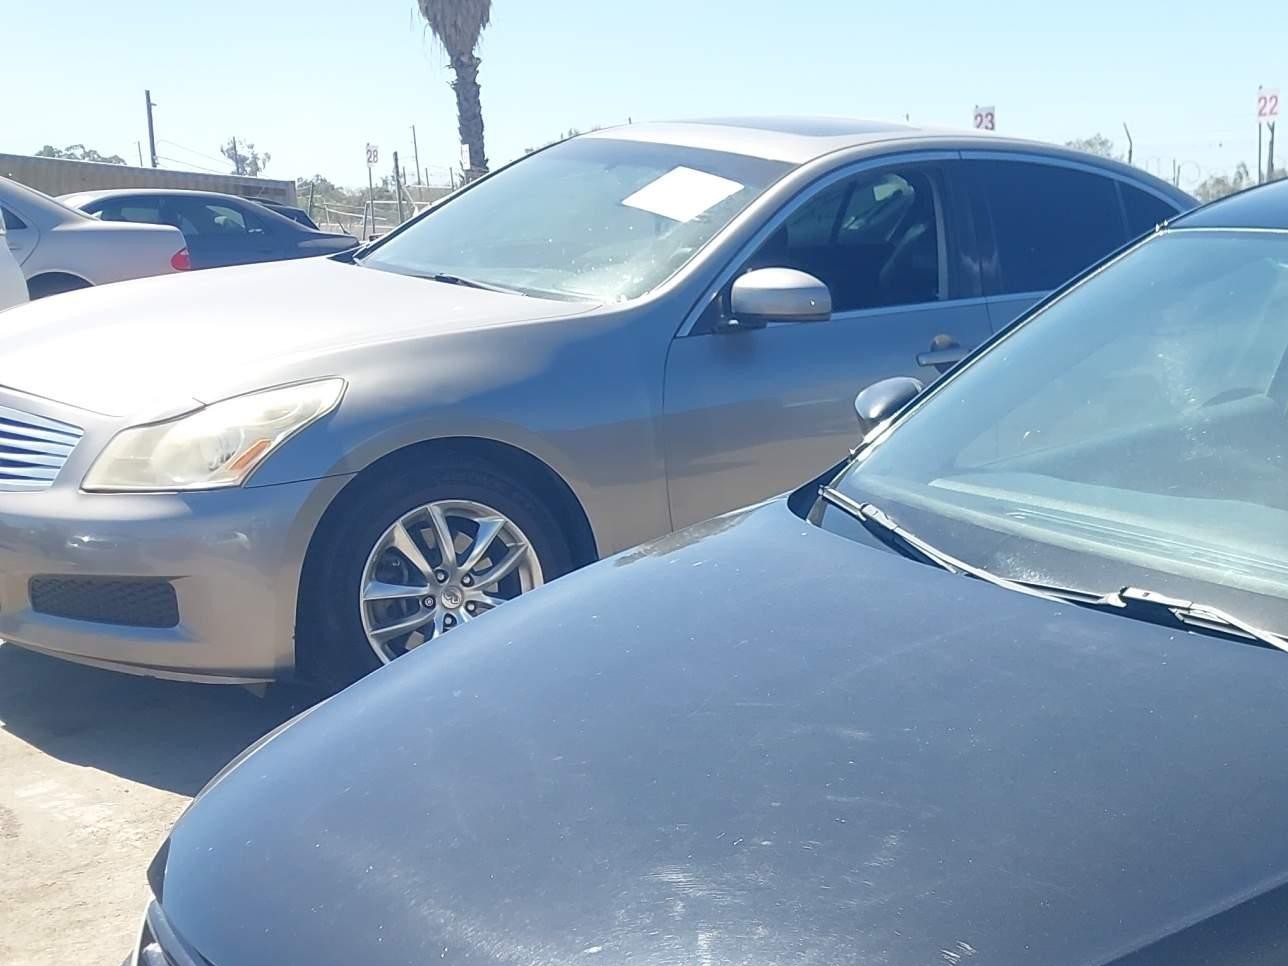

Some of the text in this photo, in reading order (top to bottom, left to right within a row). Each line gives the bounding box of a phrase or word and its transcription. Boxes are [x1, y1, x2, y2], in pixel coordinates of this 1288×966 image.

[1257, 95, 1280, 117] 22
[974, 112, 995, 130] 23
[366, 149, 379, 164] 28
